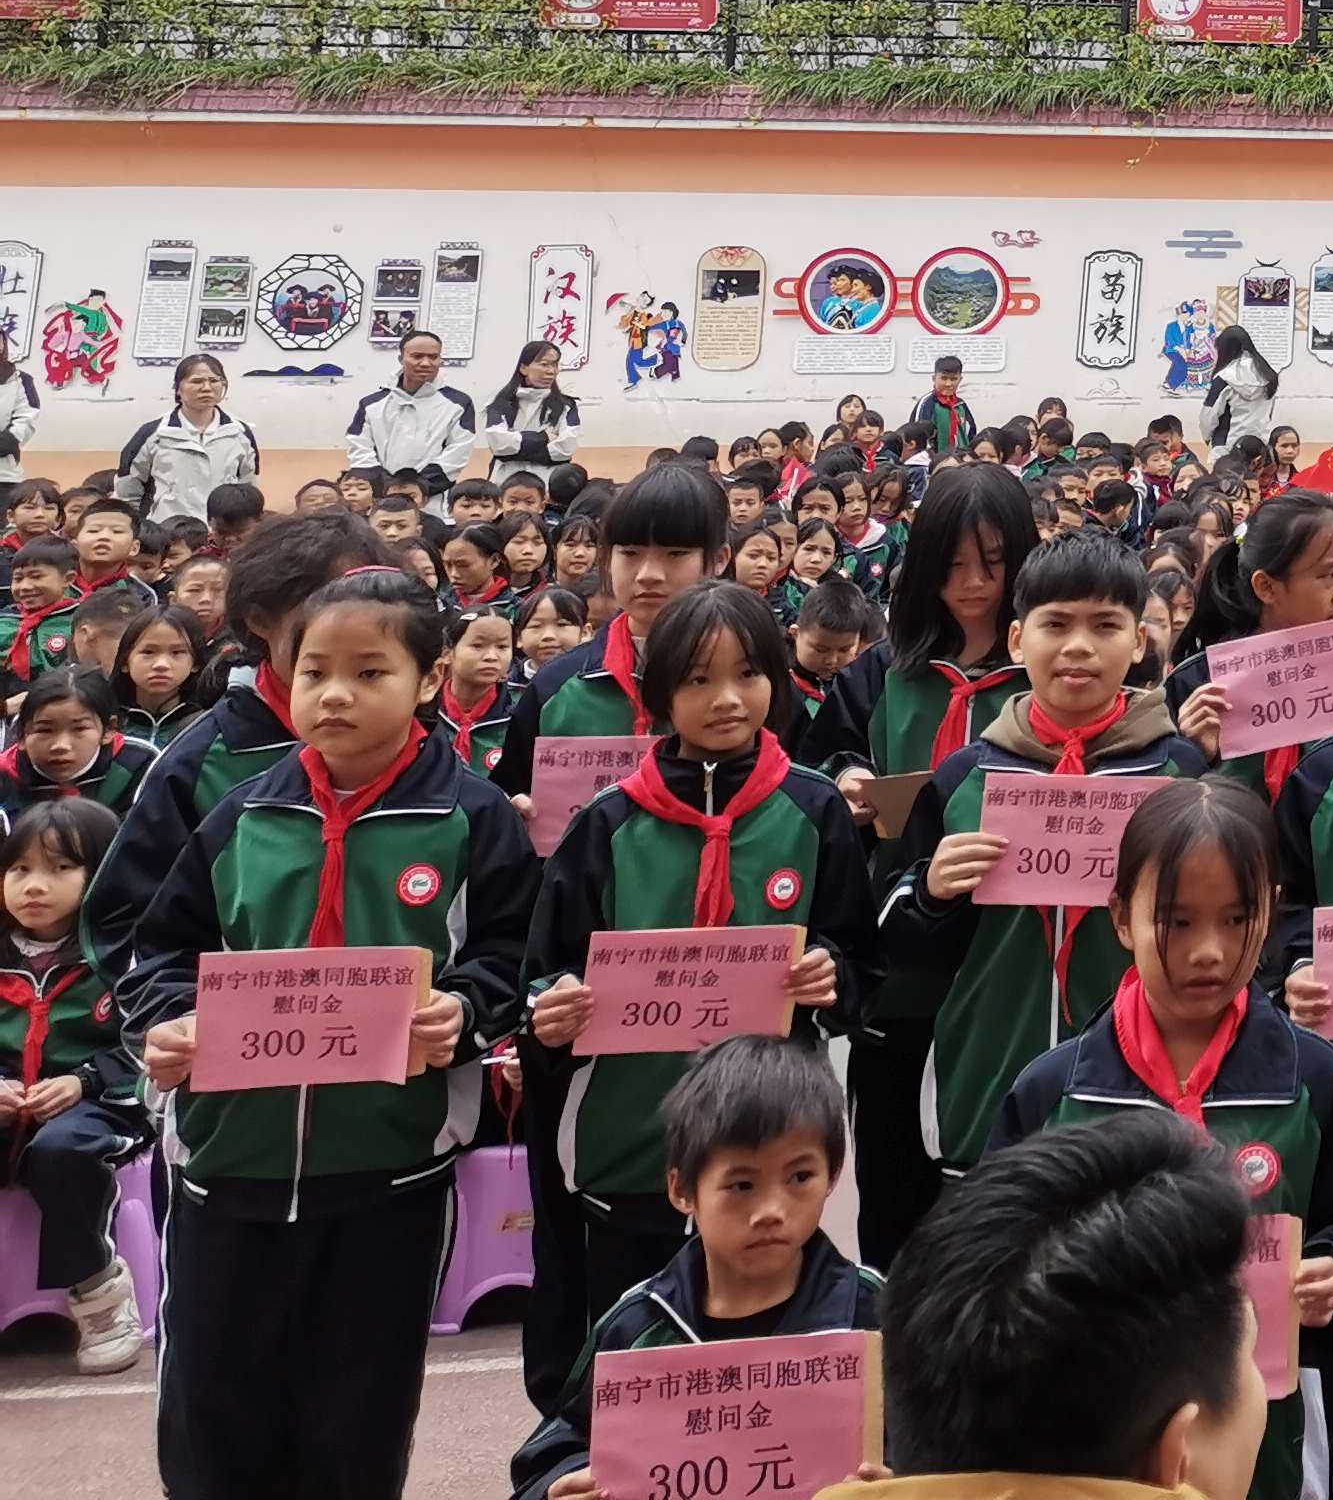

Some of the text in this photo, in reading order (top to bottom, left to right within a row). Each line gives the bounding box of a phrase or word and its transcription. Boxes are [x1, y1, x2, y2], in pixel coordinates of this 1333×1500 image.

[537, 267, 581, 348] 汉族
[1089, 269, 1126, 346] 苗族
[1267, 662, 1318, 688] 慰问金
[1251, 700, 1297, 726] 300
[1045, 815, 1104, 836] 慰问金
[1017, 847, 1116, 879] 300 元
[592, 942, 789, 967] 南宁市港澳同胞联谊
[201, 964, 414, 992] 南宁市港澳同胞联谊
[655, 969, 719, 989] 慰问金
[273, 994, 342, 1015] 慰问金
[622, 997, 730, 1029] 300 元
[241, 1026, 358, 1060] 300 元
[594, 1351, 861, 1411] 南宁市港澳同胞联谊
[686, 1402, 773, 1436] 慰问金
[649, 1444, 795, 1500] 300 元
